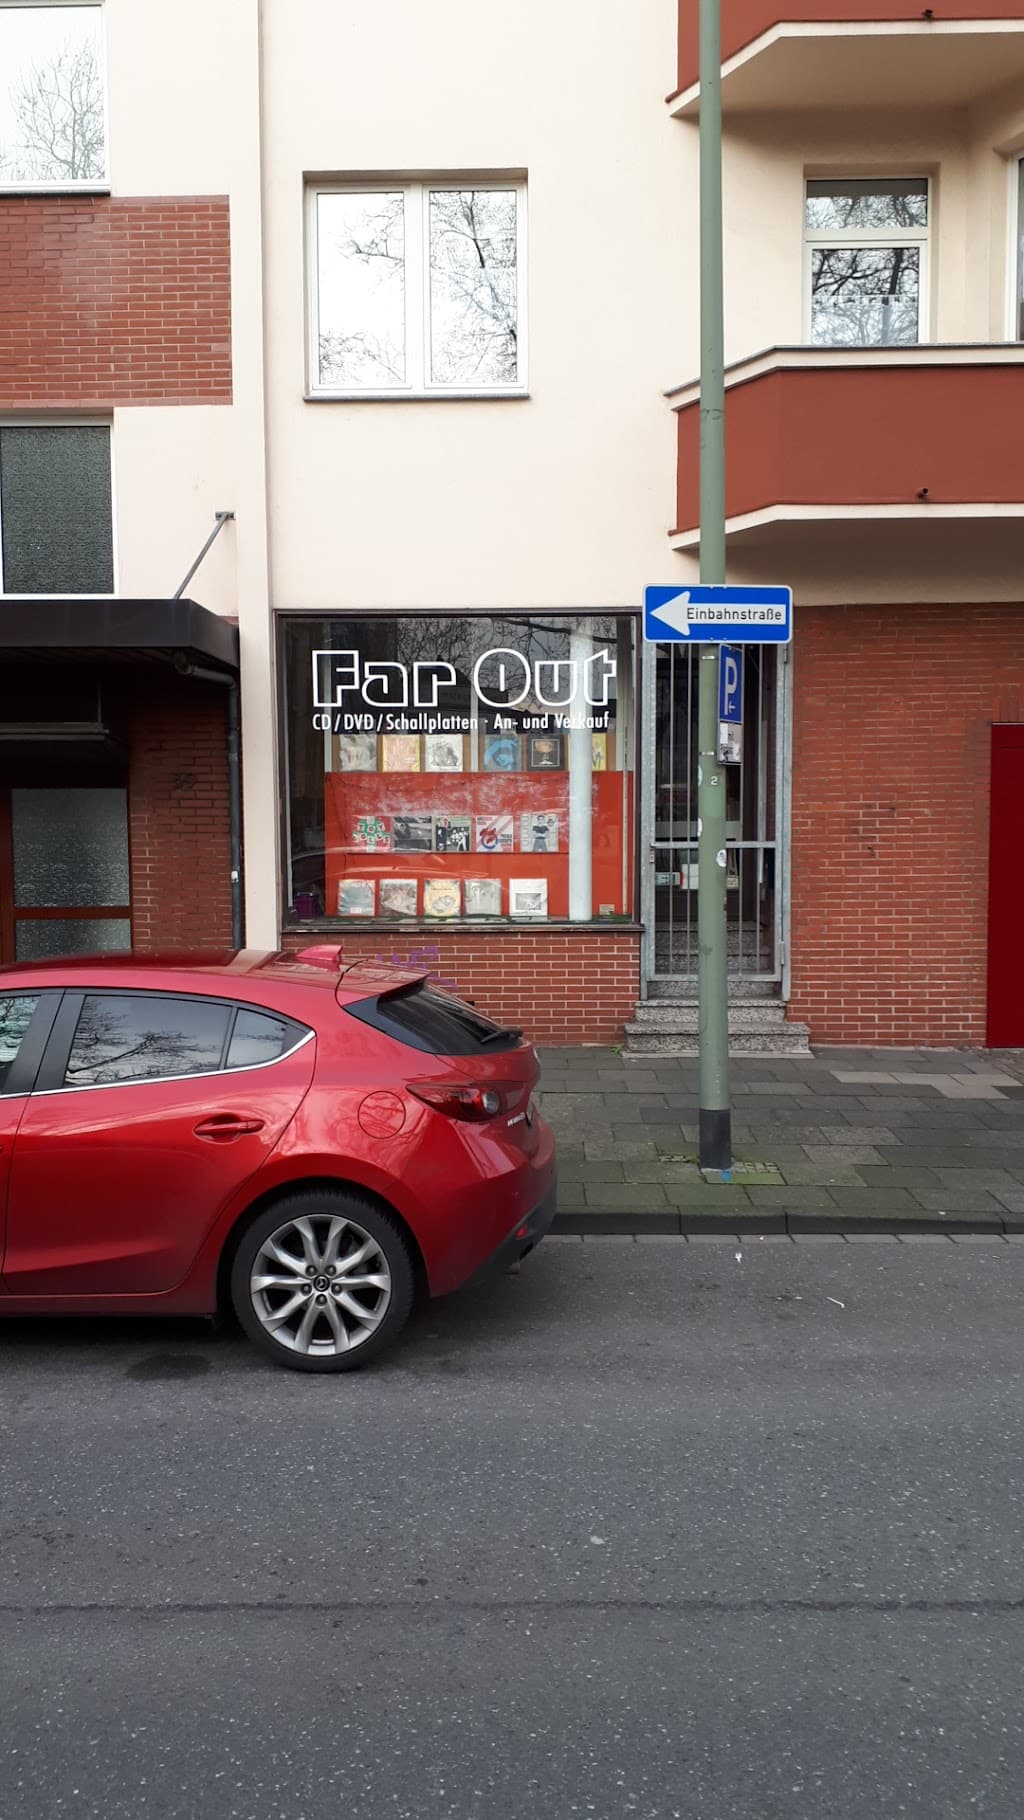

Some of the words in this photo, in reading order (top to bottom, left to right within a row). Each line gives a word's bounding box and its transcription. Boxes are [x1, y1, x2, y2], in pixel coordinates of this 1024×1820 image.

[686, 607, 782, 620] Einbahnstraße
[311, 650, 457, 707] Far
[473, 647, 617, 708] Out
[724, 657, 738, 715] P
[494, 712, 519, 730] An-
[522, 711, 549, 729] und
[710, 775, 719, 786] 2
